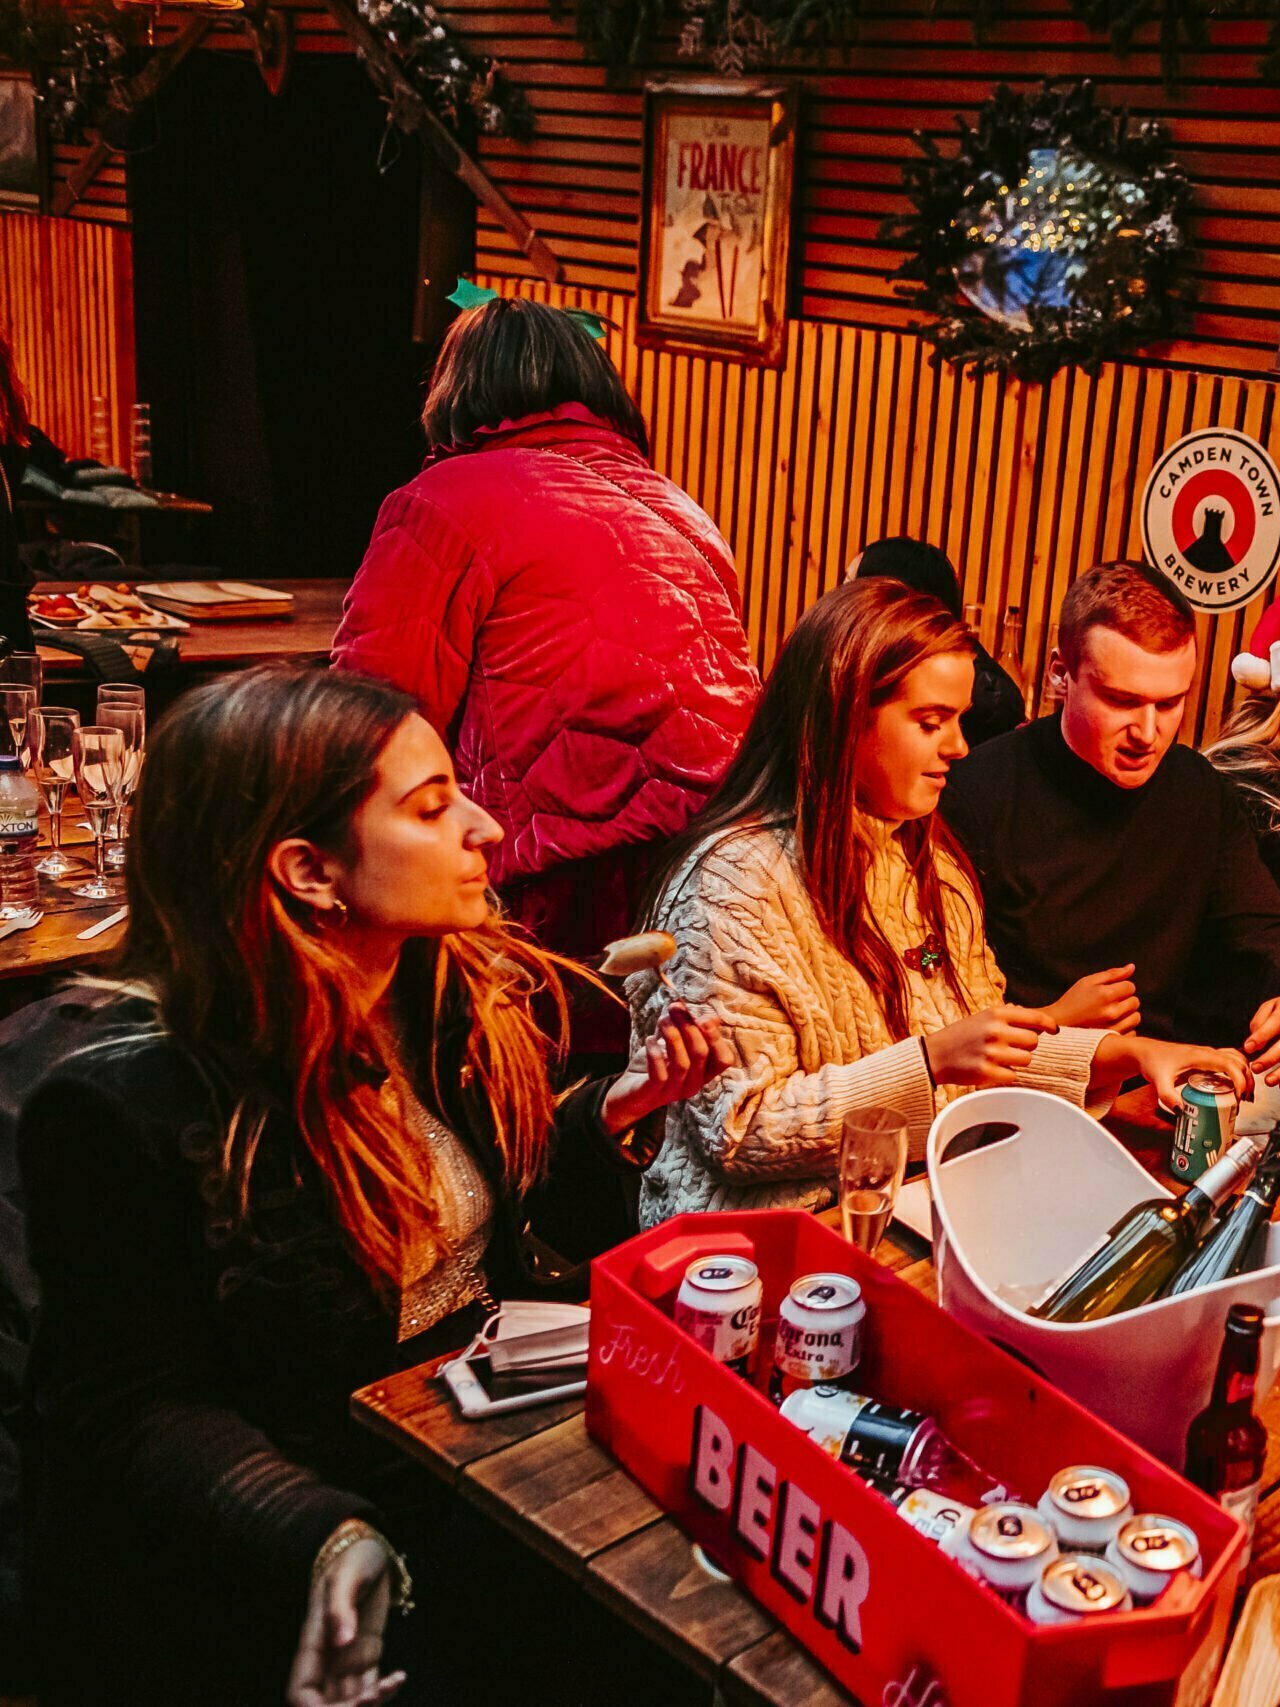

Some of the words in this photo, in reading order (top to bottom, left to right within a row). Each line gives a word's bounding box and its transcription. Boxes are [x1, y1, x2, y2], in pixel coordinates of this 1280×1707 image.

[677, 141, 763, 194] FRANCE
[1160, 447, 1232, 499] CAMDEN
[1239, 456, 1274, 517] TOWN
[1164, 553, 1251, 596] BREWERY
[600, 1321, 686, 1393] Fresh
[785, 1340, 825, 1362] Extra
[691, 1404, 870, 1654] BEER
